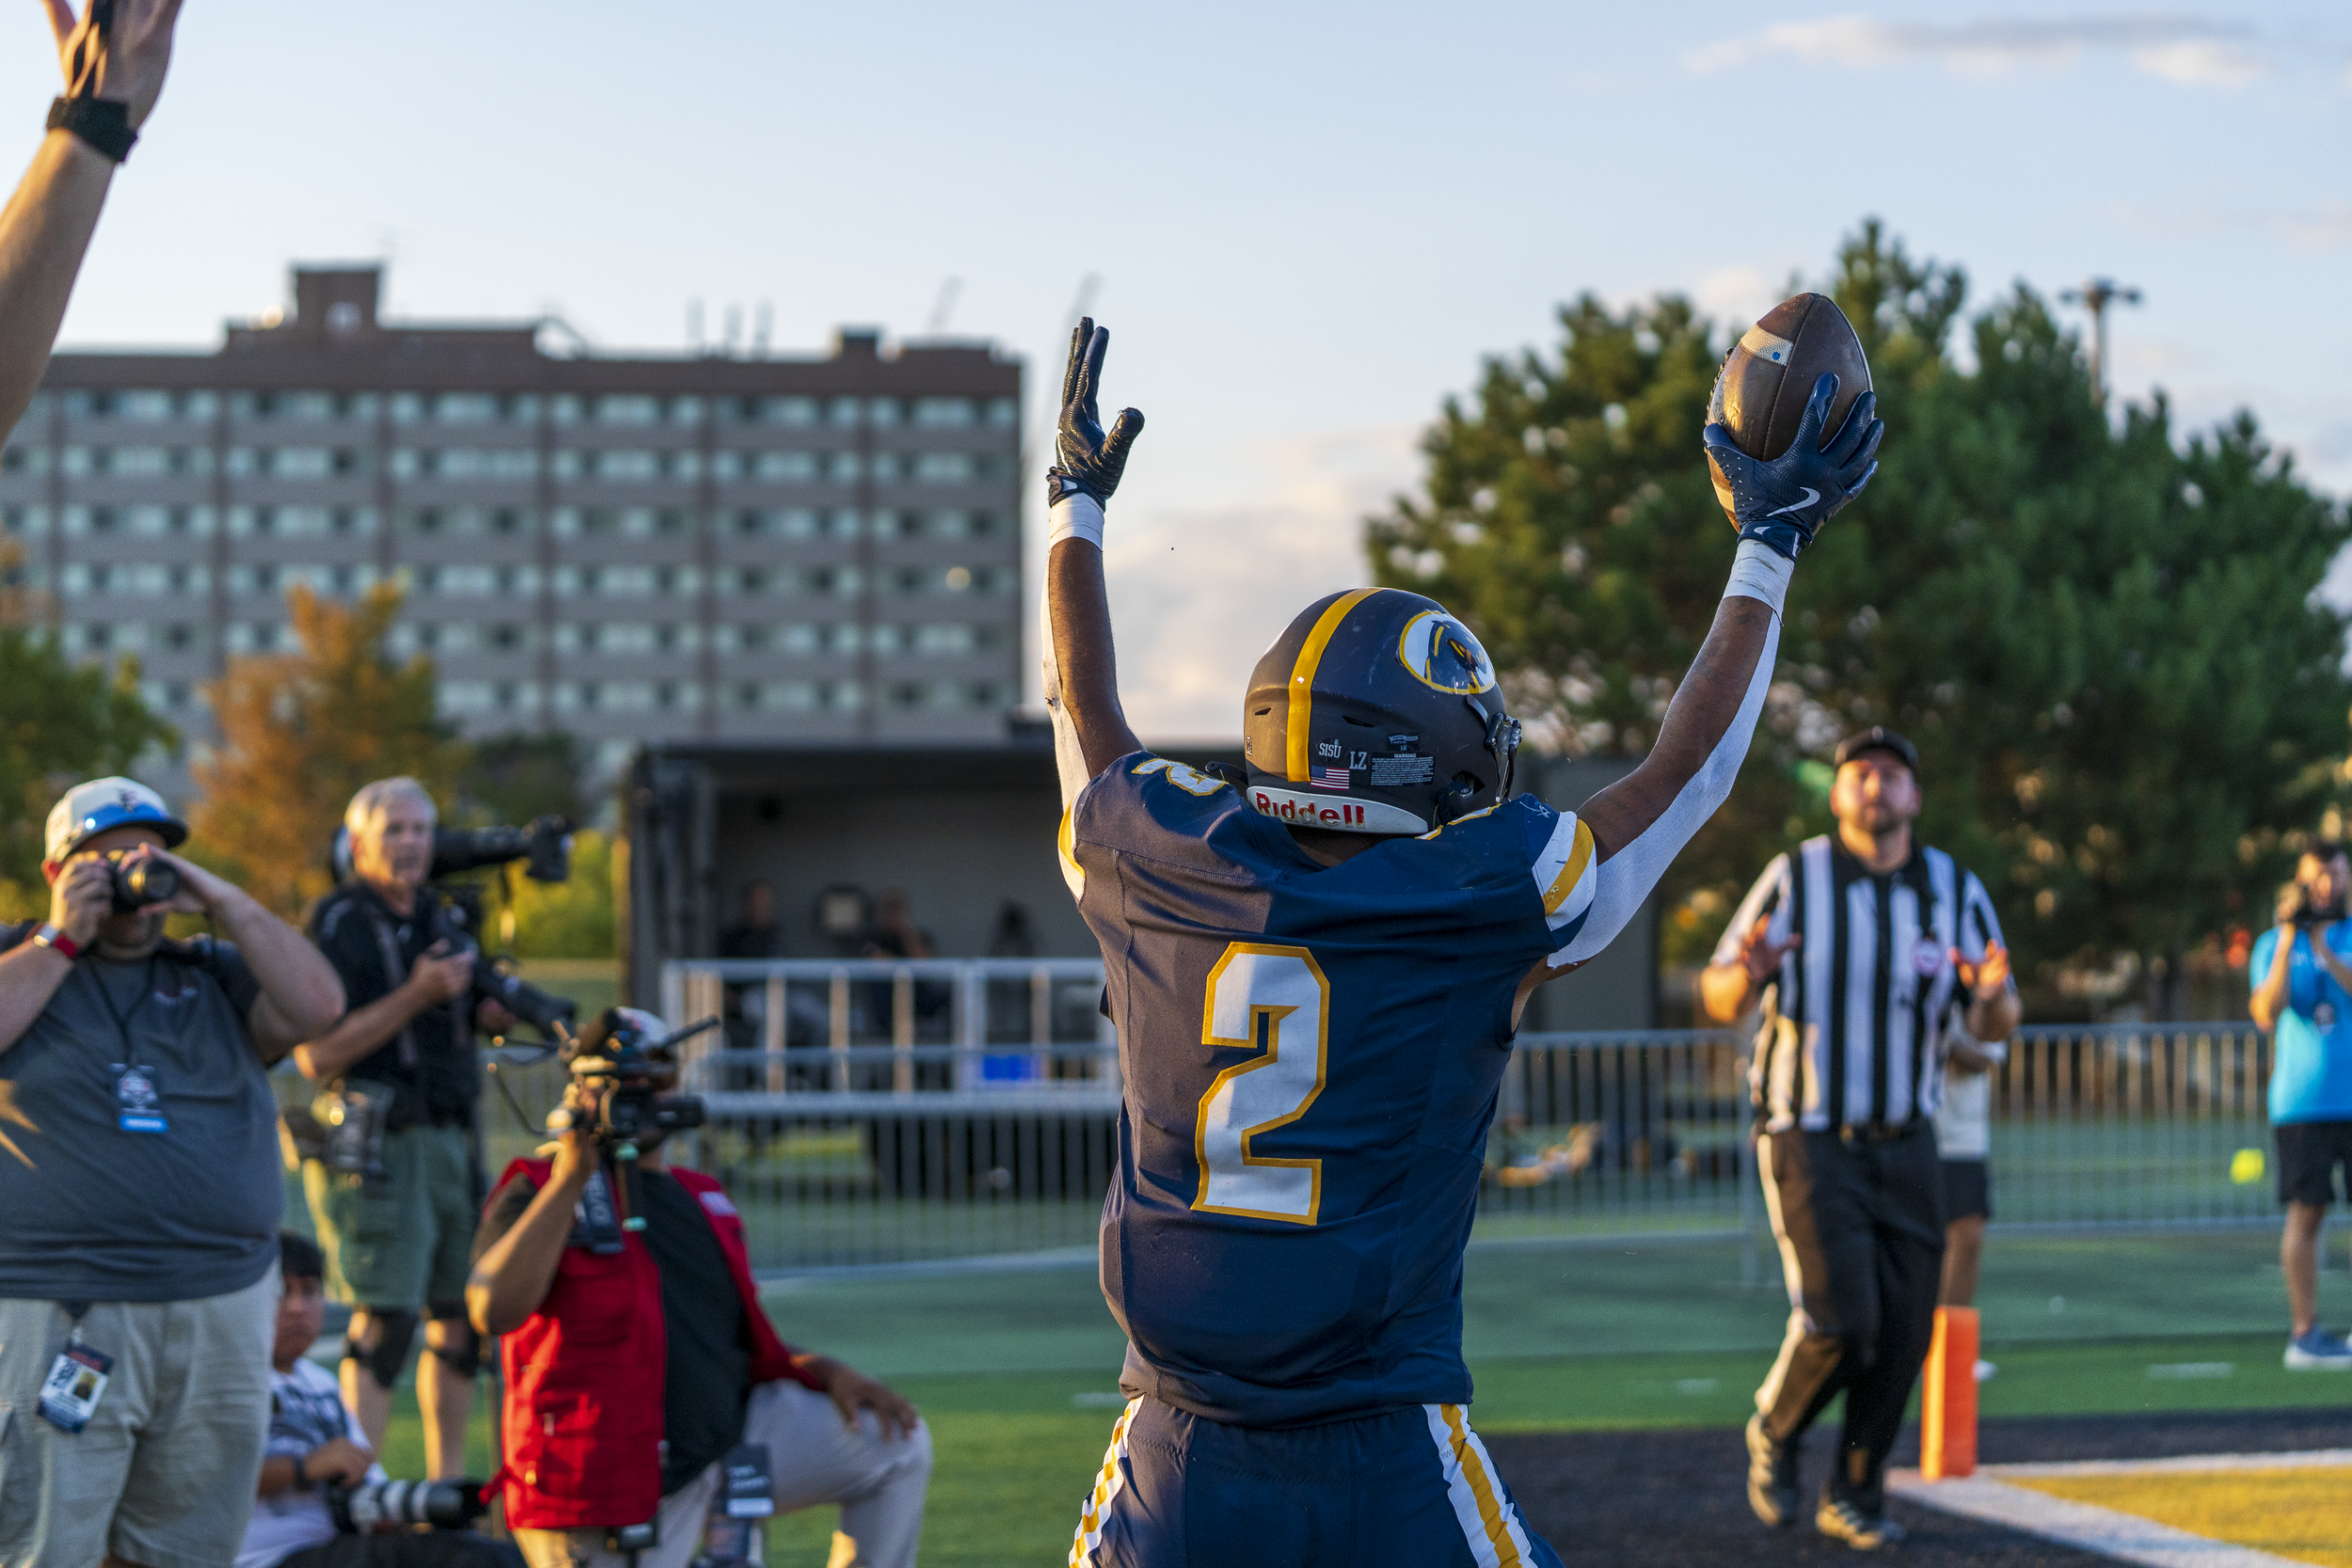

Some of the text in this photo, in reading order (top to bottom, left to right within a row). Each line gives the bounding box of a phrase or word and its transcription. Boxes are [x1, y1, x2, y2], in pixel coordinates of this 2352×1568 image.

[1319, 742, 1342, 758] SISU
[1349, 751, 1367, 770] LZ
[1256, 792, 1366, 829] Riddell
[1190, 941, 1330, 1226] 2
